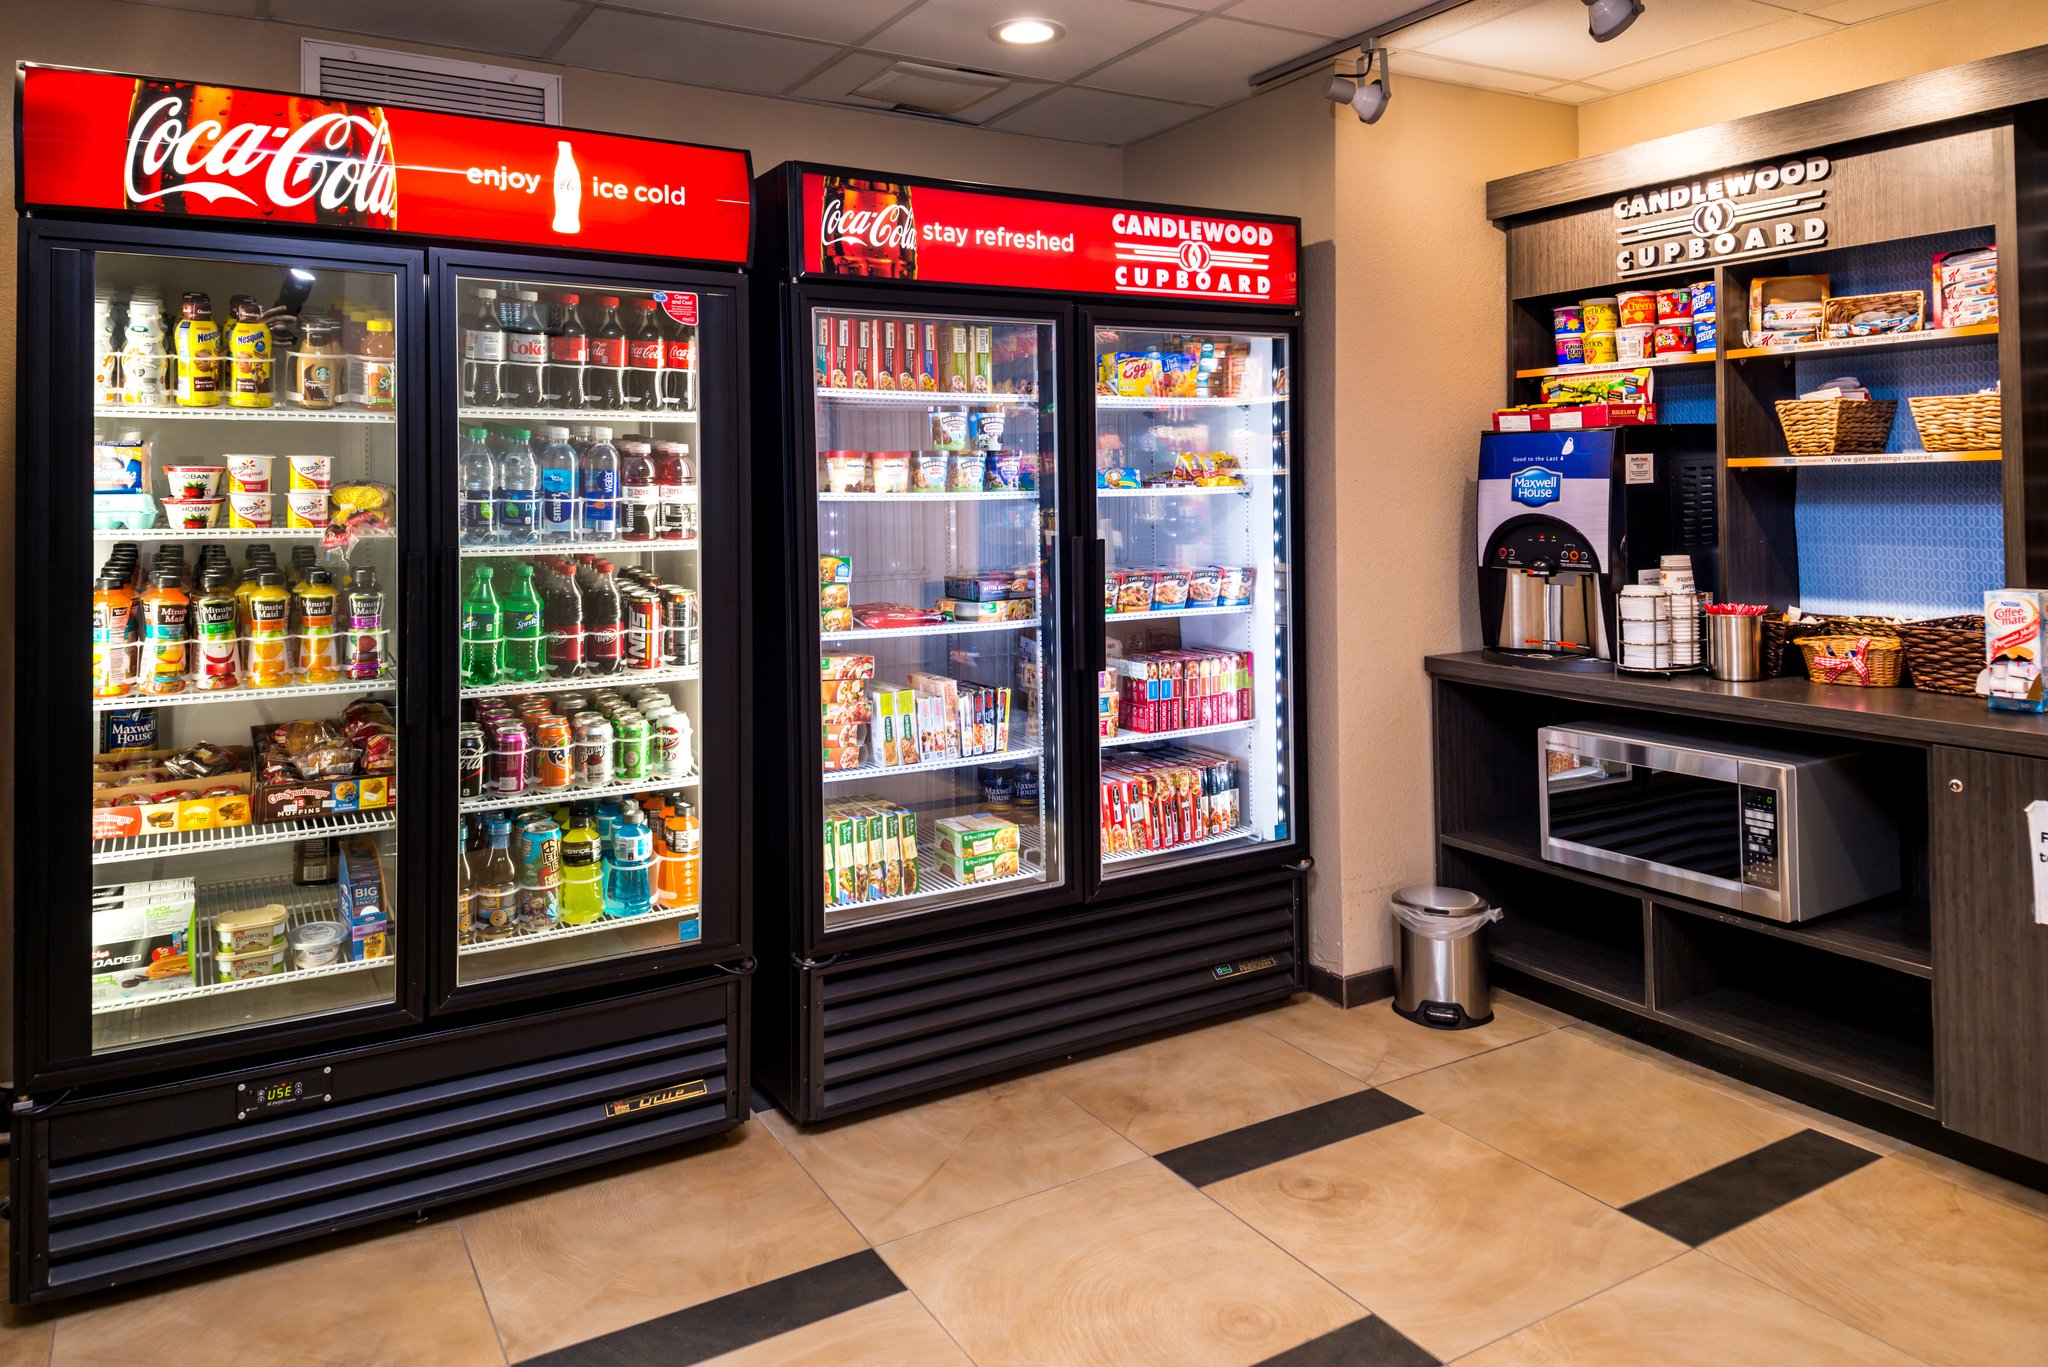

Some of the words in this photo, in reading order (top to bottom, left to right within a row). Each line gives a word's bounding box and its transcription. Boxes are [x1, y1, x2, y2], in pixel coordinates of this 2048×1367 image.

[124, 97, 398, 219] Coca-Cola
[466, 165, 541, 194] enjoy
[592, 176, 628, 200] ice
[633, 184, 686, 206] cold
[1613, 156, 1831, 219] CANDLEWOOD
[821, 199, 917, 251] Coca-Cola
[1111, 213, 1274, 247] CANDLEWOOD
[922, 221, 968, 247] stay
[975, 225, 1075, 253] refreshed
[1616, 217, 1827, 271] CUPBOARD
[1114, 265, 1271, 294] CUPBOARD
[238, 330, 265, 345] Nesquik
[1829, 339, 1849, 347] We've
[1852, 338, 1864, 346] got
[1866, 334, 1899, 344] mornings
[1902, 331, 1934, 340] covered.
[510, 339, 546, 356] Coke
[1123, 359, 1153, 380] Eggo
[1853, 457, 1866, 465] got
[1867, 455, 1901, 464] mornings
[1903, 454, 1935, 462] covered.
[1515, 476, 1557, 489] Maxwell
[1518, 487, 1552, 498] House
[204, 606, 233, 615] Minute
[254, 603, 283, 612] Minute
[302, 600, 331, 608] Minute
[160, 607, 187, 616] Minute
[207, 612, 229, 621] Maid
[258, 609, 279, 618] Maid
[305, 607, 327, 615] Maid
[356, 608, 376, 616] Maid
[164, 614, 185, 623] Maid
[517, 616, 538, 630] Sprite
[2002, 615, 2028, 626] mate
[628, 604, 646, 659] NOS
[112, 719, 157, 735] Maxwell
[117, 731, 153, 744] House
[985, 785, 1013, 795] Maxwell
[1014, 781, 1038, 790] Maxwel
[988, 793, 1010, 802] House
[277, 807, 321, 817] MUFFINS
[355, 886, 378, 898] BIG
[93, 954, 142, 969] OADED
[267, 1086, 292, 1101] USE
[639, 1088, 685, 1108] true
